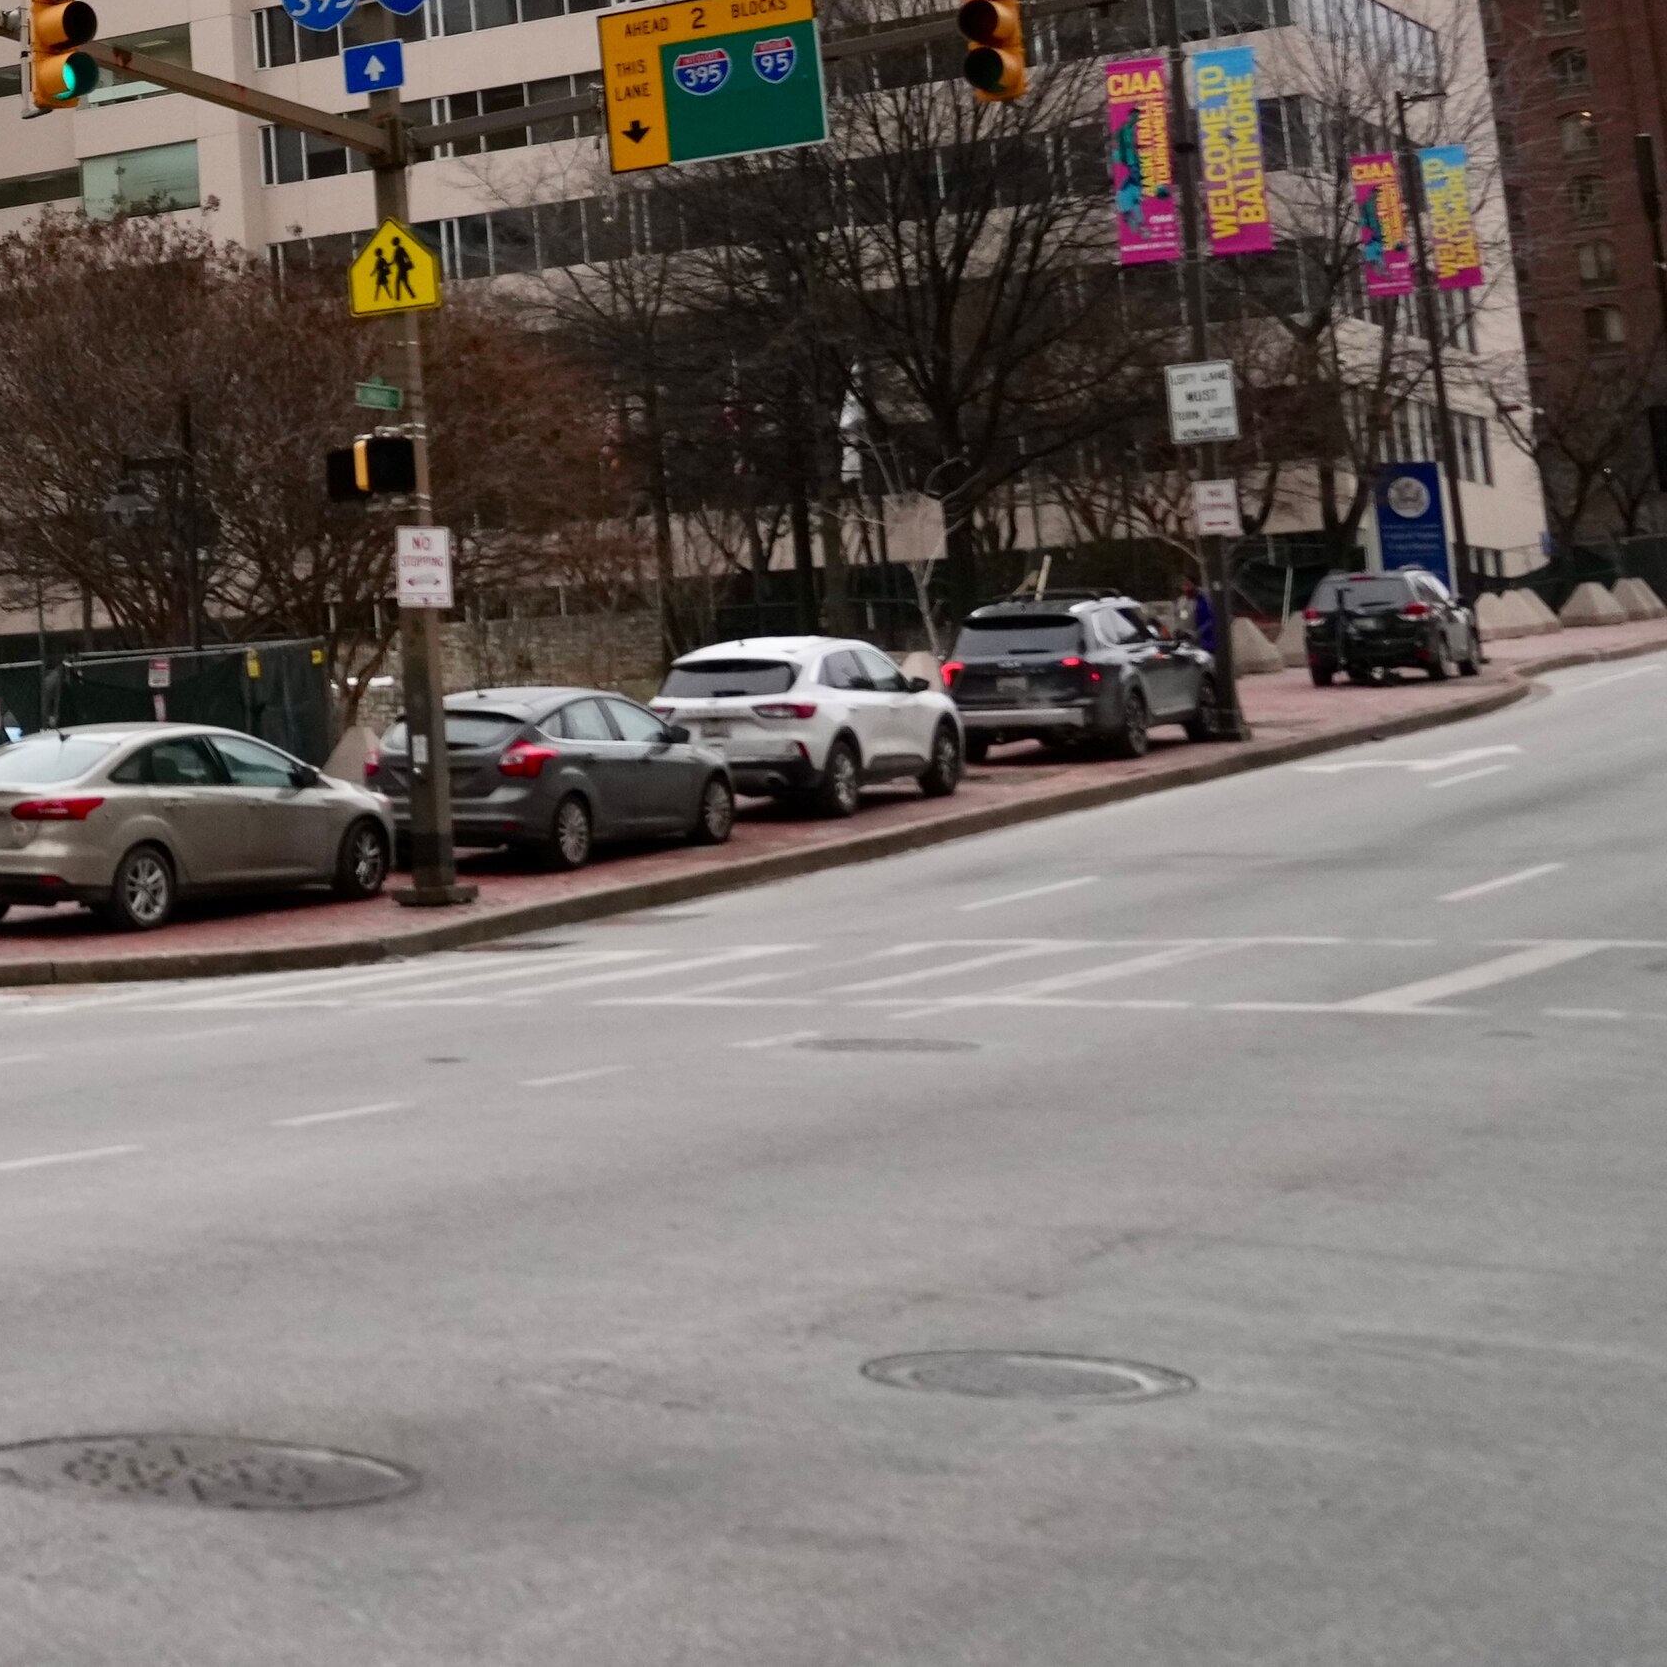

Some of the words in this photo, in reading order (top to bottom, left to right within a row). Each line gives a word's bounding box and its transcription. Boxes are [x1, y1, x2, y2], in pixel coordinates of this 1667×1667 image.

[624, 17, 668, 38] AHEAD
[691, 8, 706, 29] 2
[615, 60, 646, 77] THIS
[760, 53, 791, 73] 95
[685, 64, 722, 87] 395
[1107, 70, 1164, 97] CIAA
[1198, 66, 1227, 101] TO
[615, 84, 651, 101] LANE
[1227, 74, 1266, 224] BALTIMORE
[1202, 106, 1240, 239] WELCOME
[1186, 389, 1218, 402] MUST
[412, 536, 431, 551] NO
[401, 555, 444, 567] STOPPING
